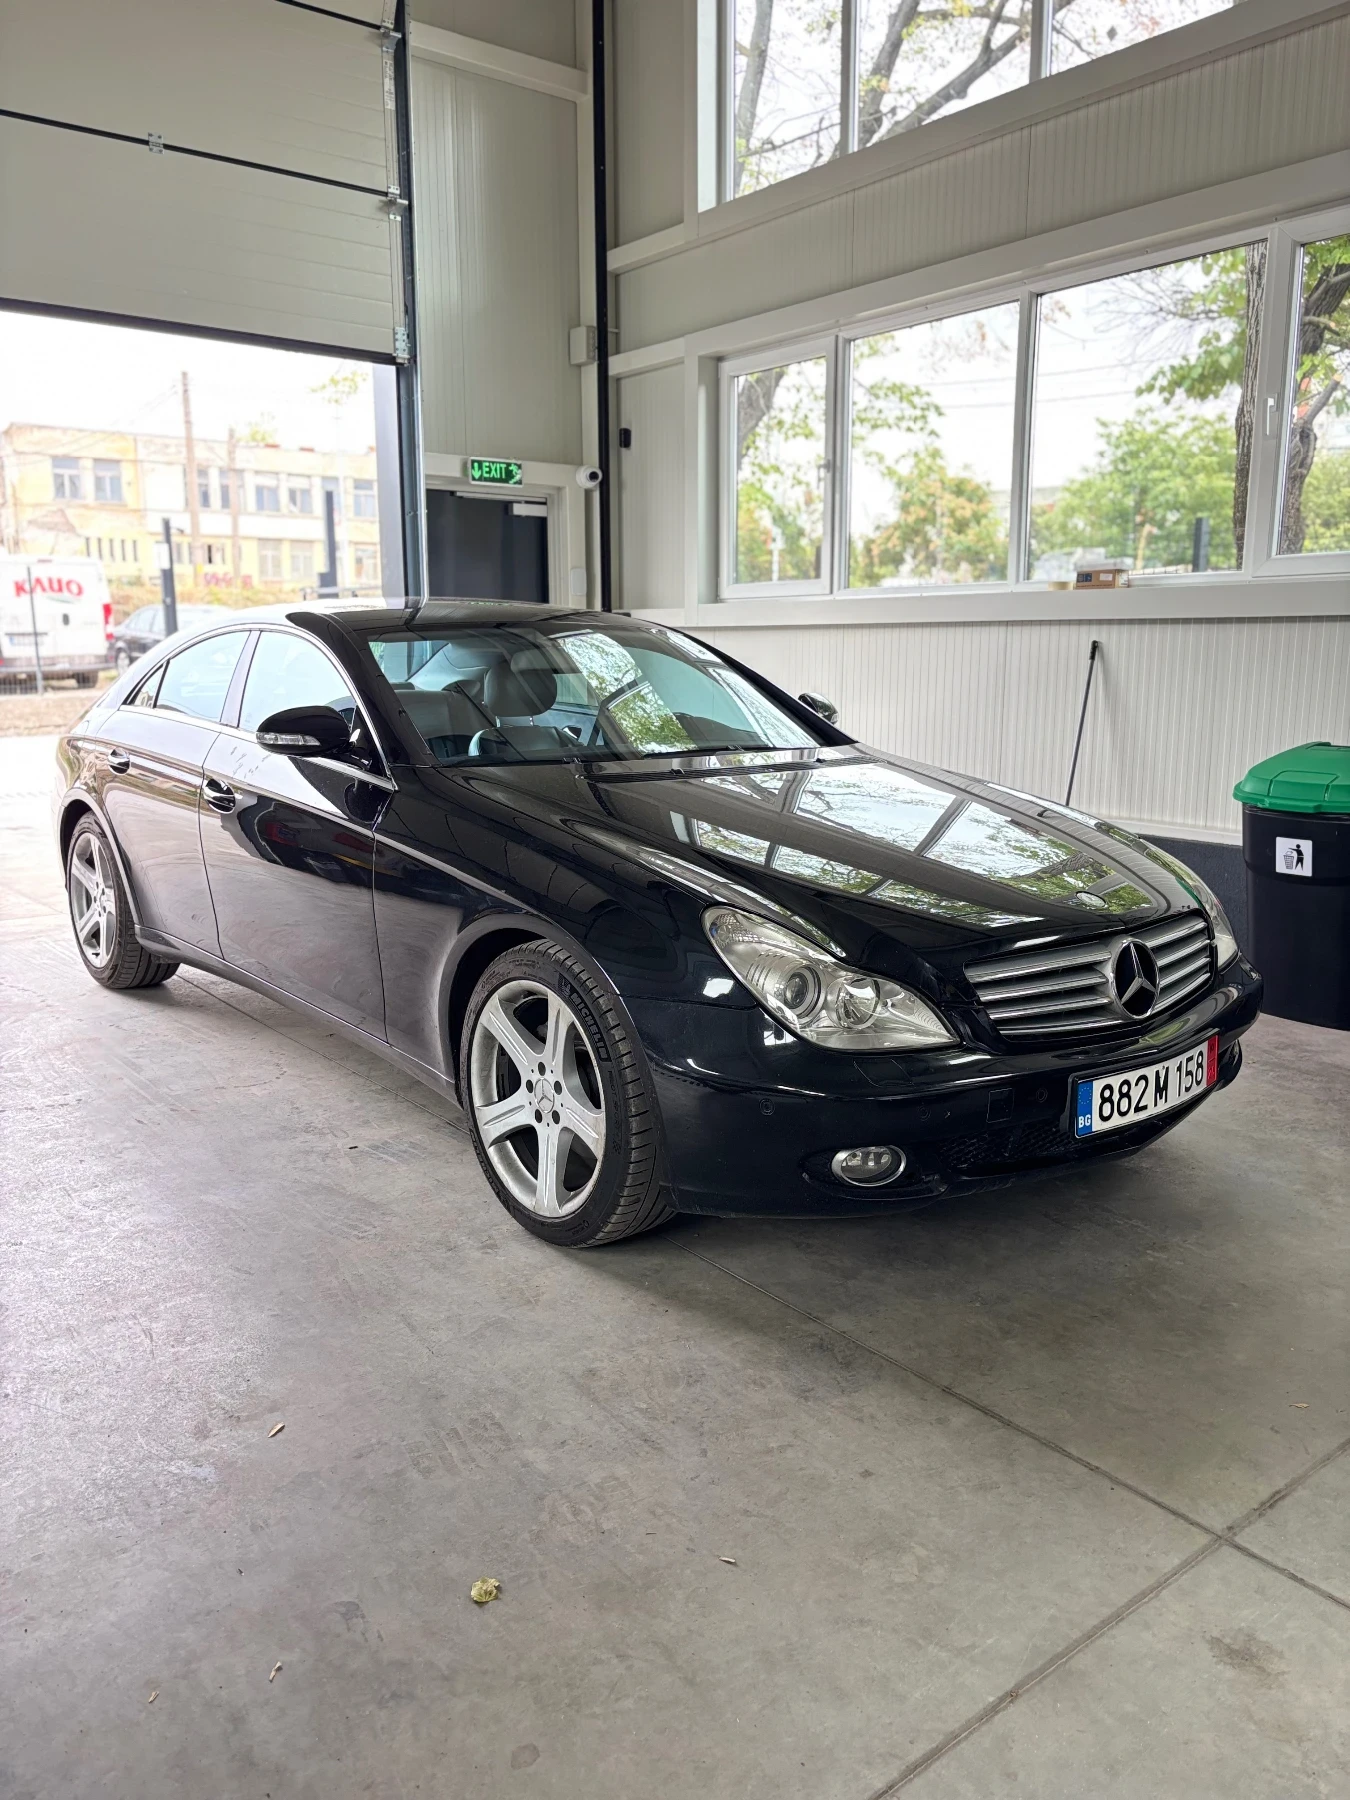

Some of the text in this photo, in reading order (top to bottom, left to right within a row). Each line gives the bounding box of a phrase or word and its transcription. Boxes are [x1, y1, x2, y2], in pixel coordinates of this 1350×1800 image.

[482, 462, 506, 478] EXIT
[1099, 1050, 1204, 1122] 882 M 158
[1078, 1114, 1091, 1128] BG
